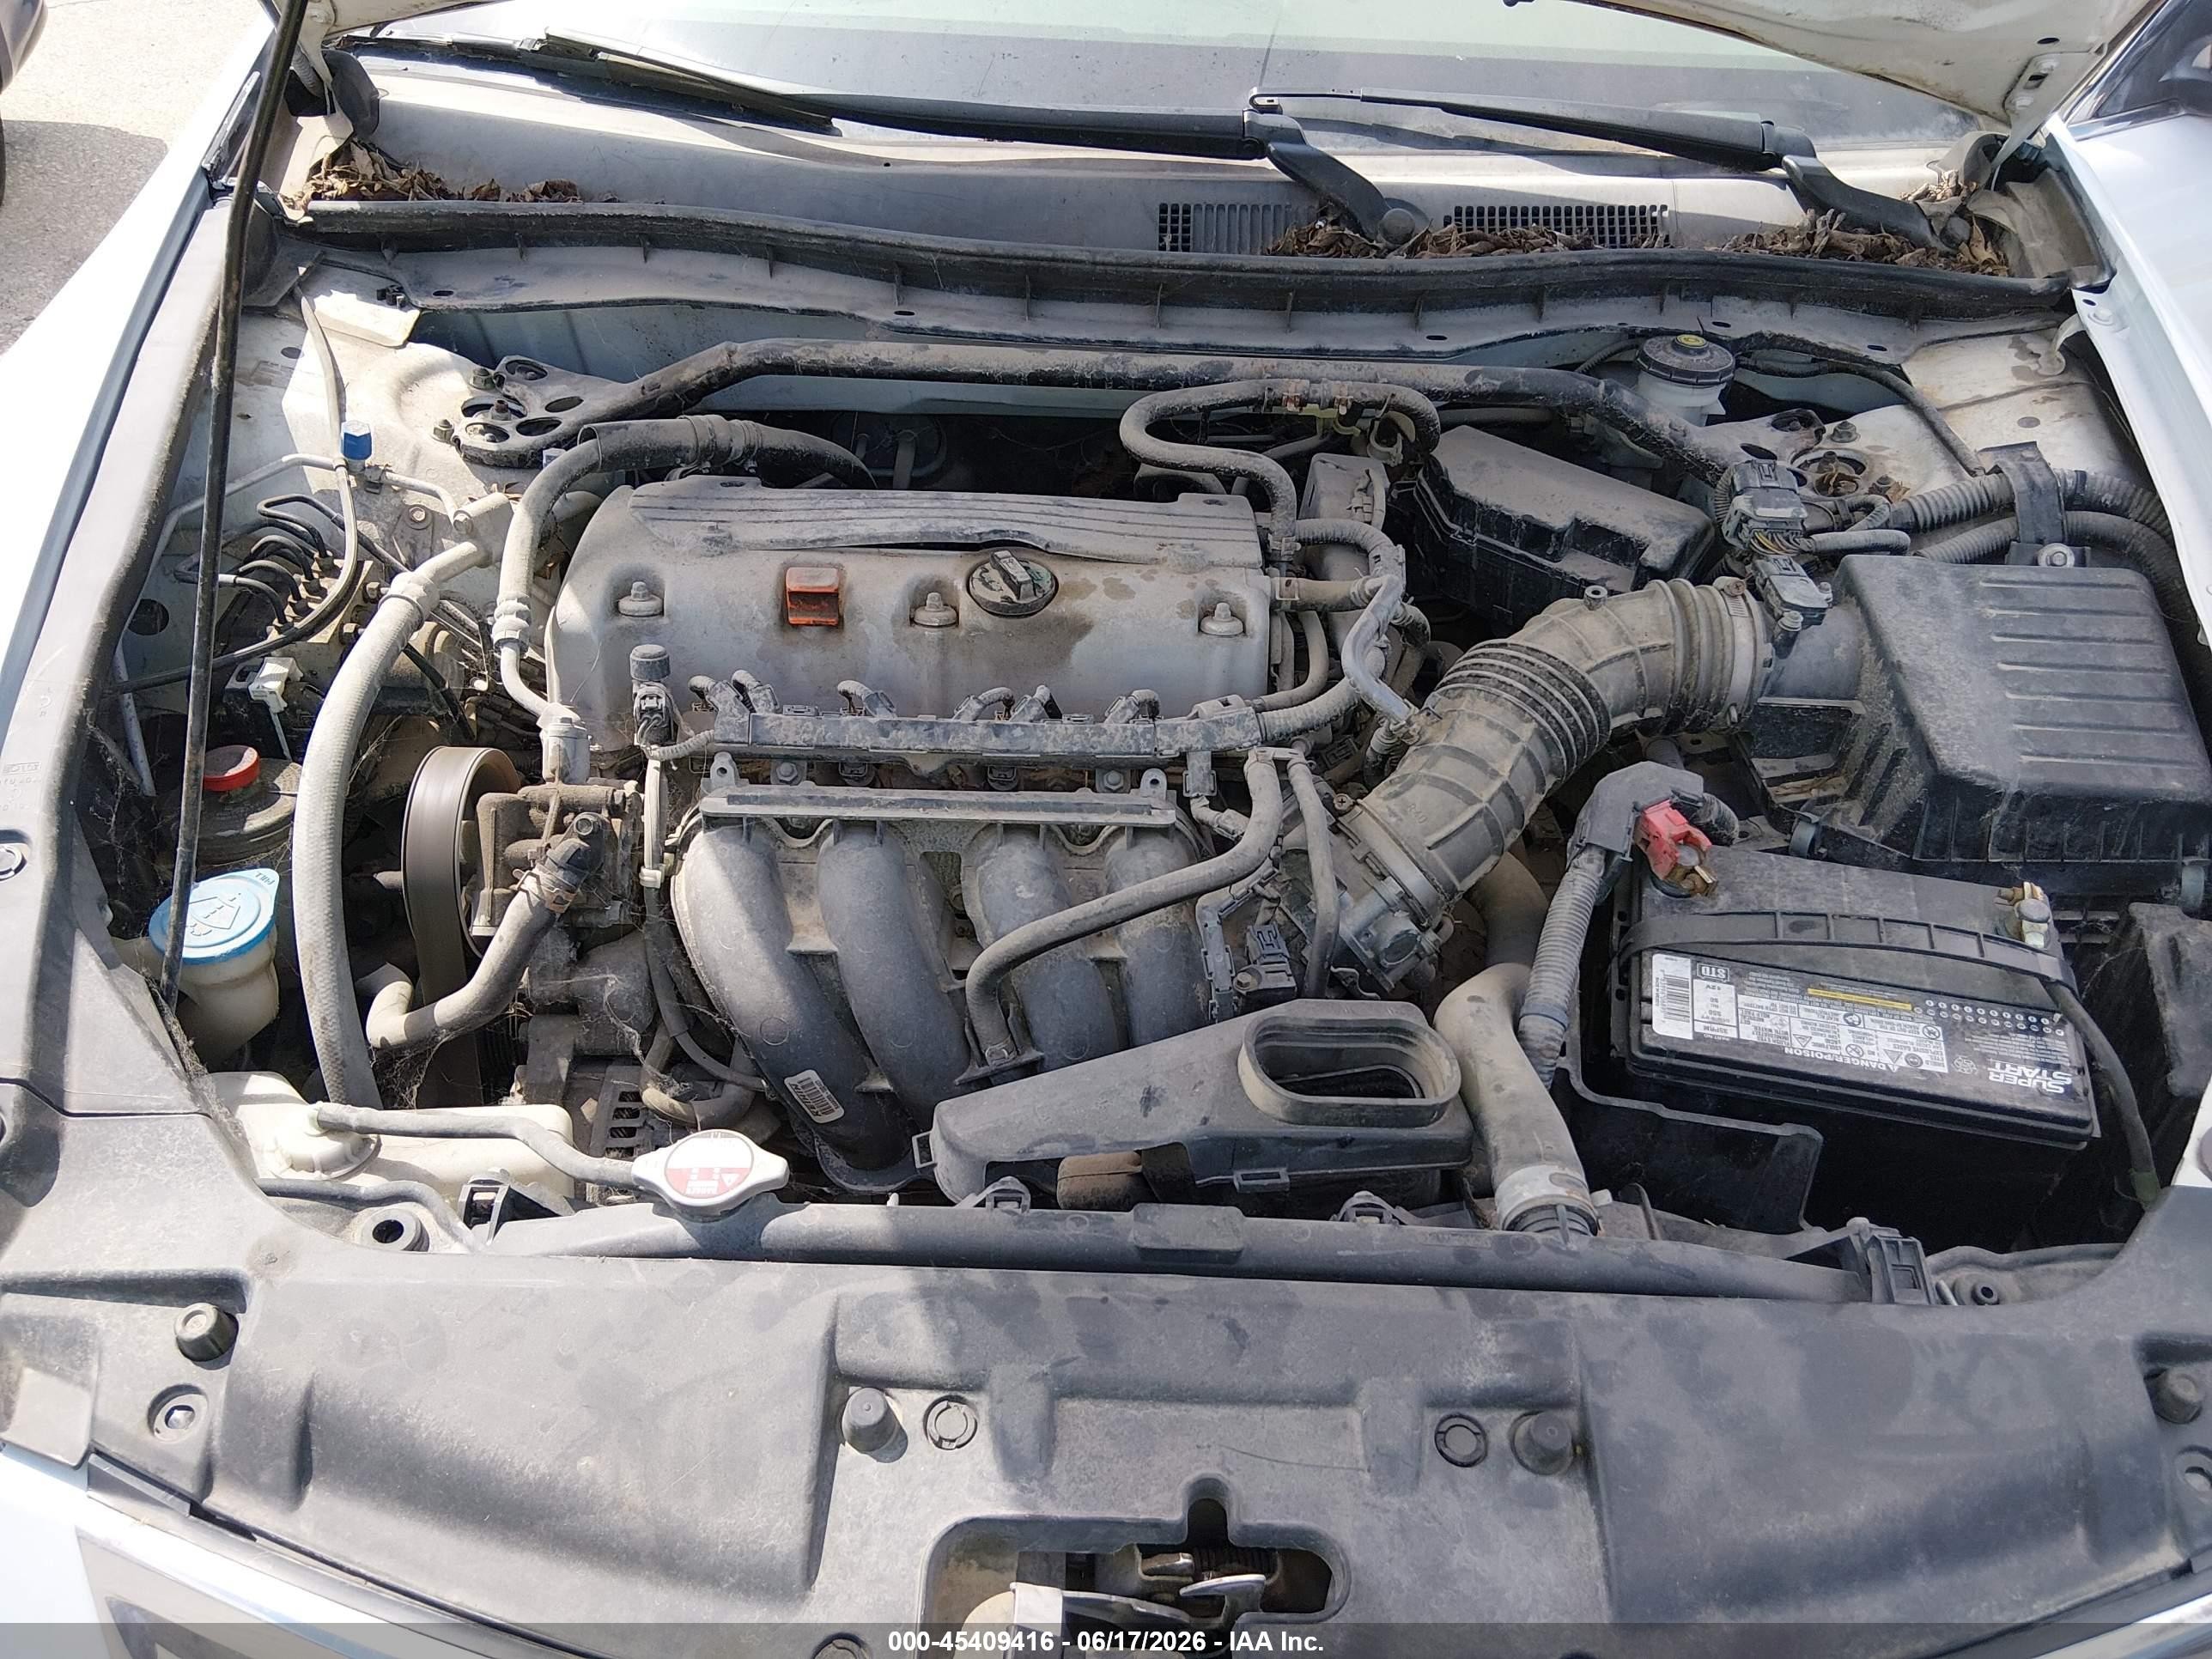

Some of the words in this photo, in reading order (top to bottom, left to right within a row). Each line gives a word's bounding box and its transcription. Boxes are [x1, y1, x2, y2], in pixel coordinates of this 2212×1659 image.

[1700, 965, 1725, 978] STD
[1784, 1046, 1886, 1070] DANGER/POISON
[1989, 1071, 2065, 1094] SUPER
[1990, 1062, 2072, 1085] START
